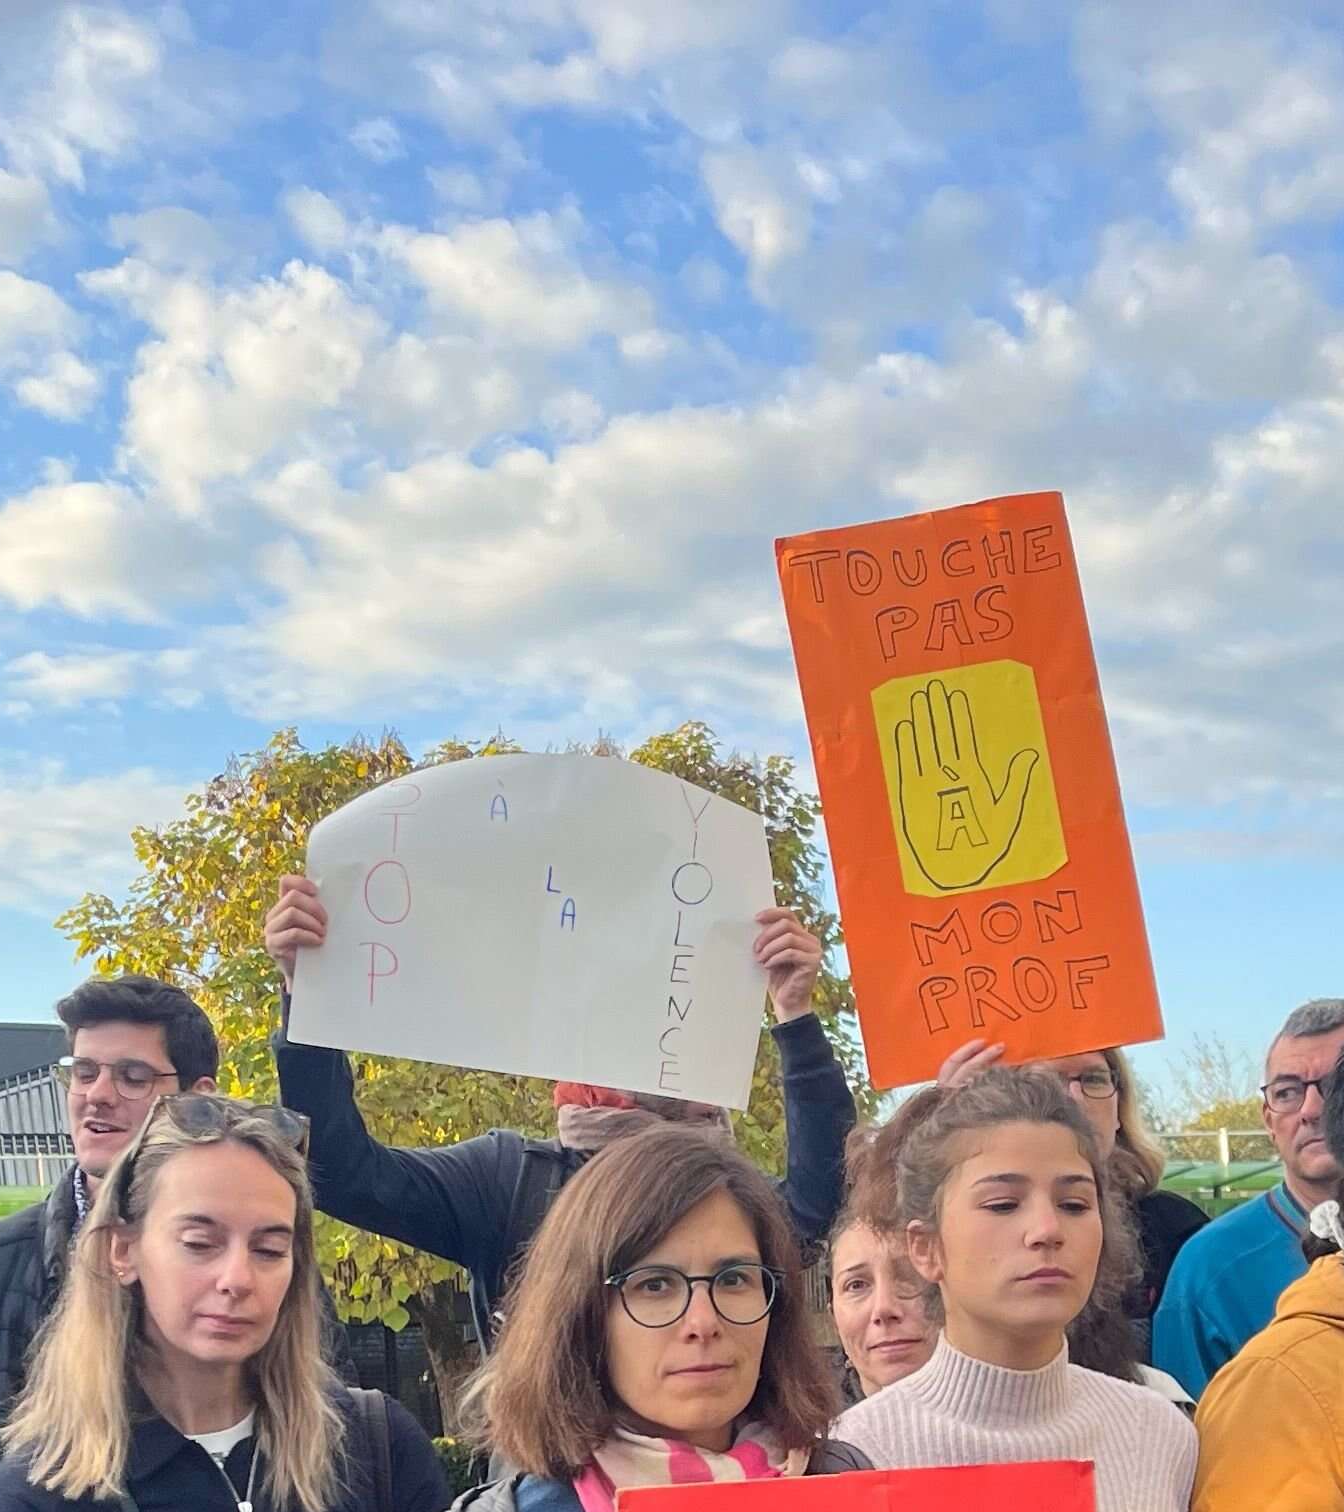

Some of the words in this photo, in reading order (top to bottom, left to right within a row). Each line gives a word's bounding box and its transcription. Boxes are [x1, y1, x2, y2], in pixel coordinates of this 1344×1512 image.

[789, 525, 1062, 603] TOUCHE
[875, 585, 1014, 662] PAS
[911, 891, 1082, 966] MON
[918, 956, 1110, 1034] PROF
